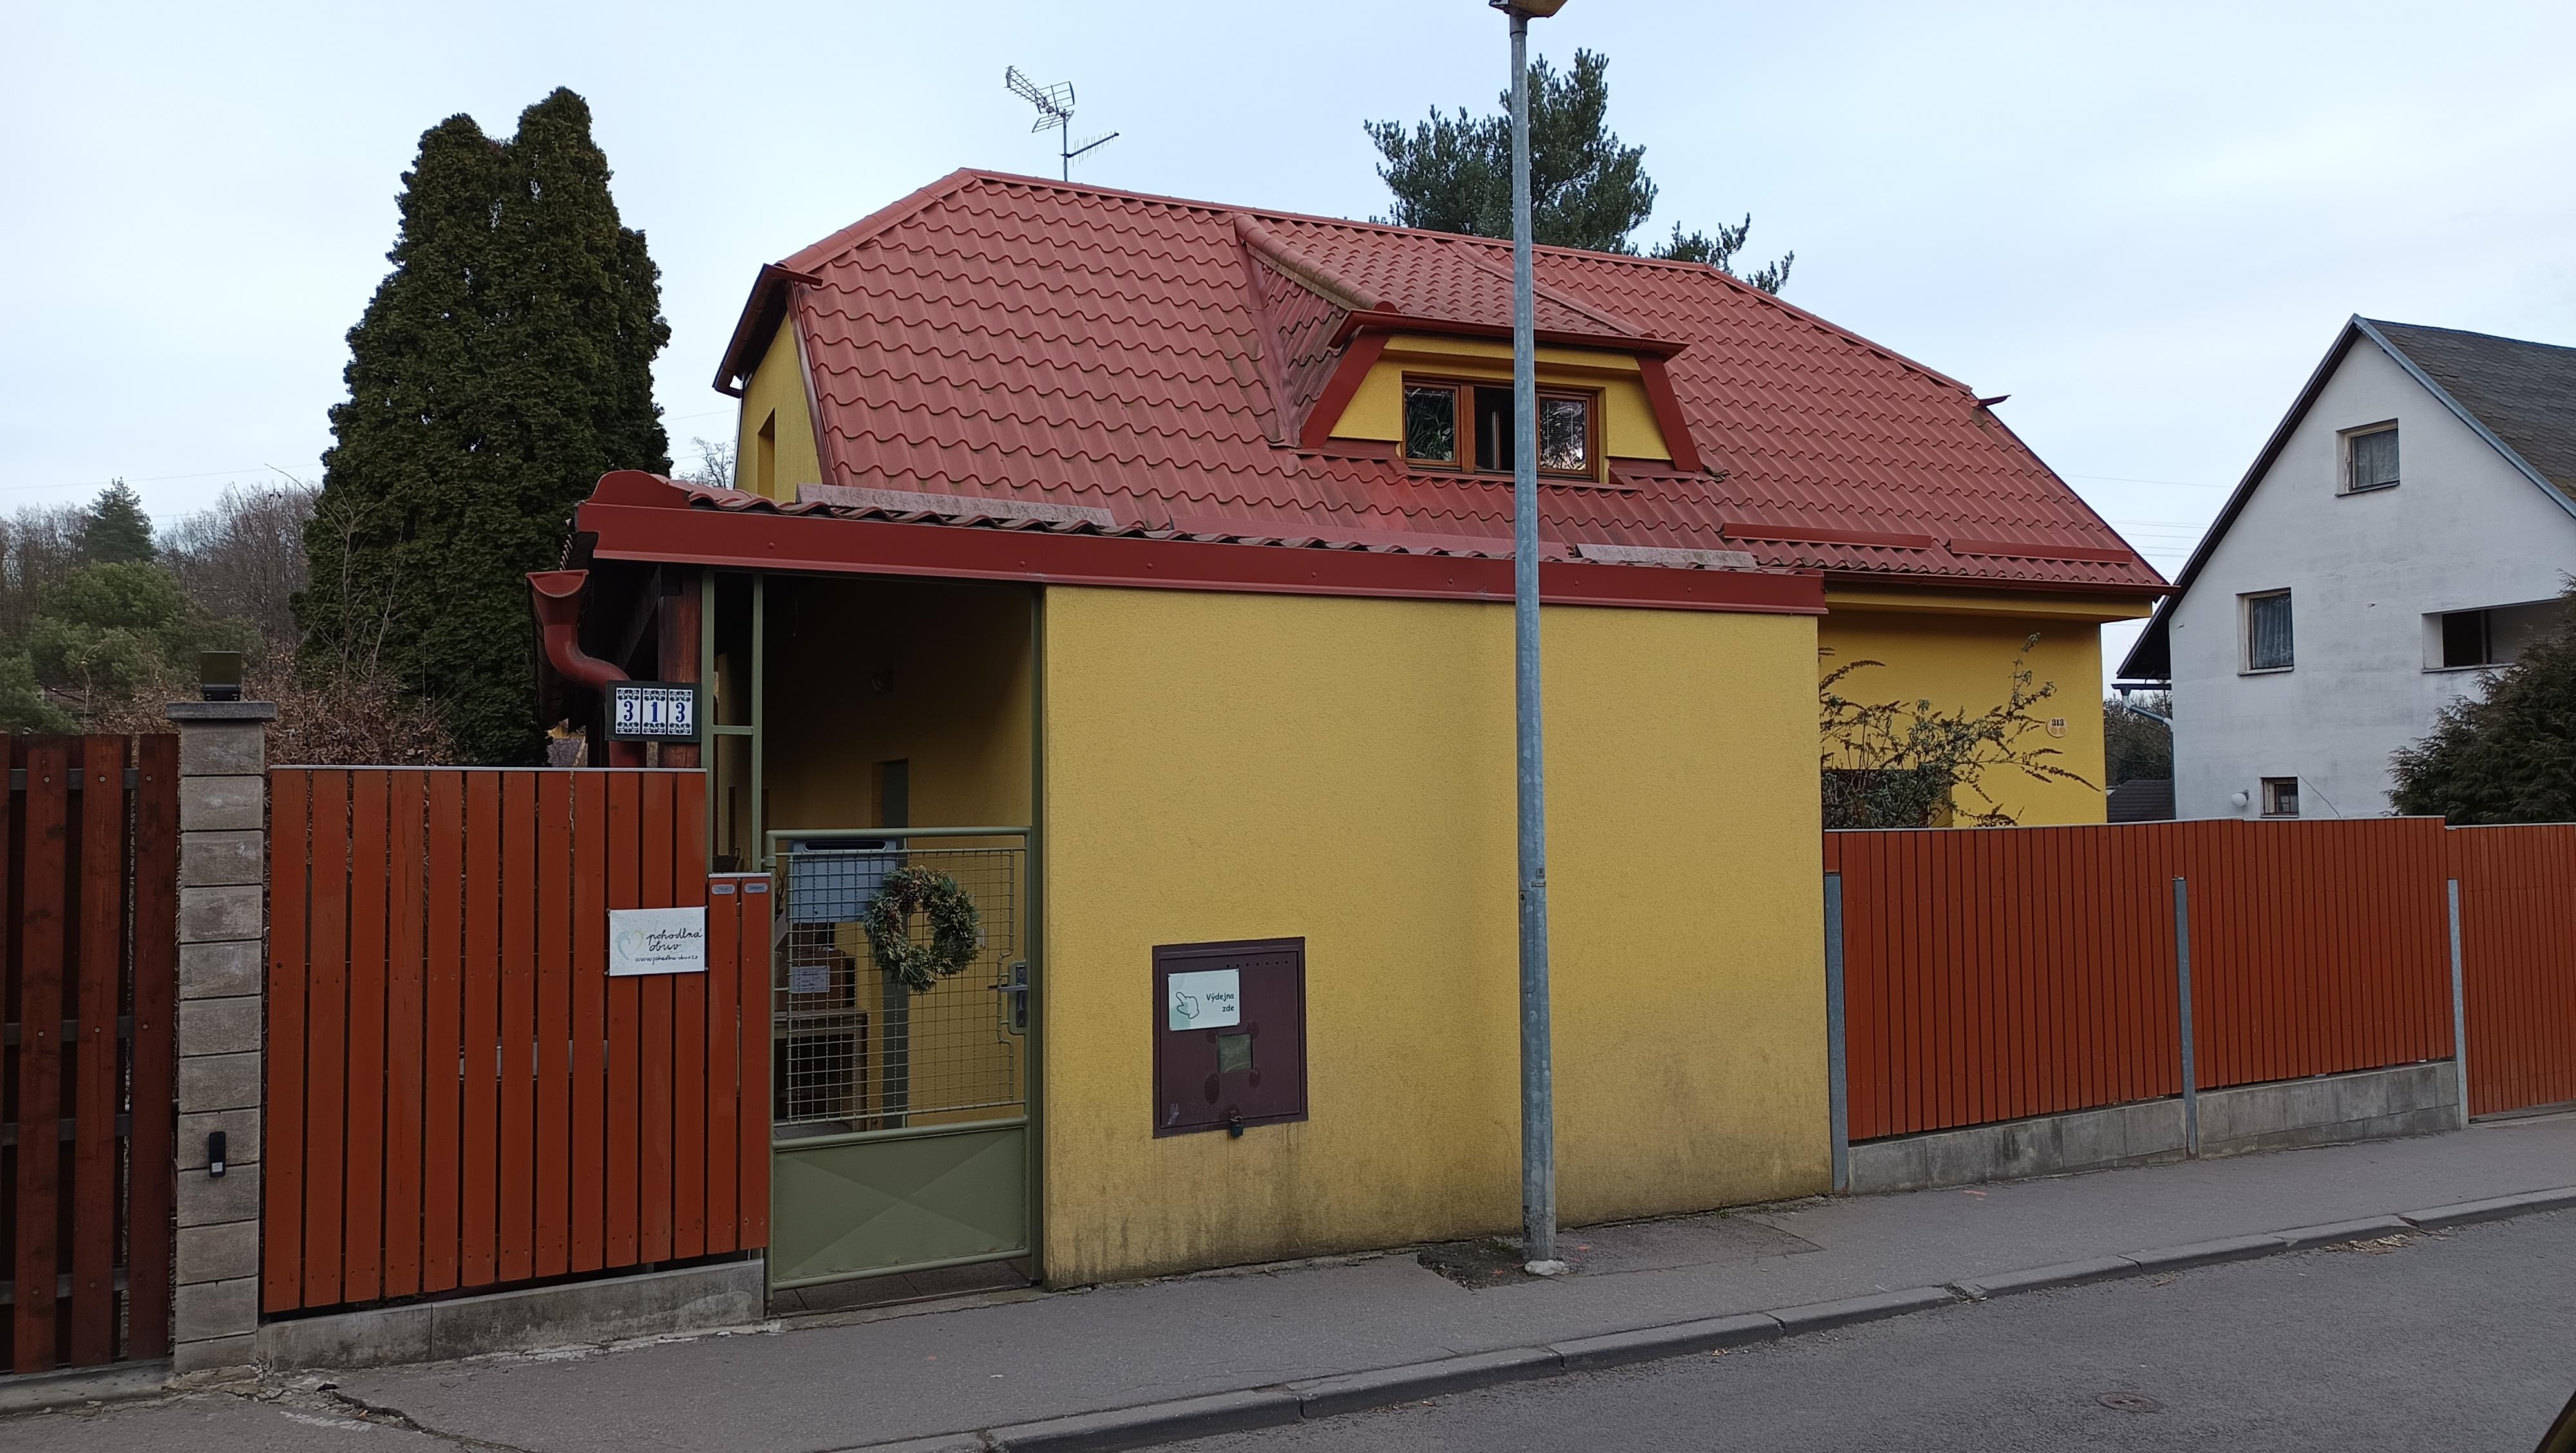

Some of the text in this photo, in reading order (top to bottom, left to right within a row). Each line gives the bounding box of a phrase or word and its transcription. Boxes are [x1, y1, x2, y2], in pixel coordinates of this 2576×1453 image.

[623, 701, 685, 723] 313
[646, 927, 703, 945] pohodlná
[649, 941, 681, 951] obuv
[1206, 992, 1235, 1002] Výdejna
